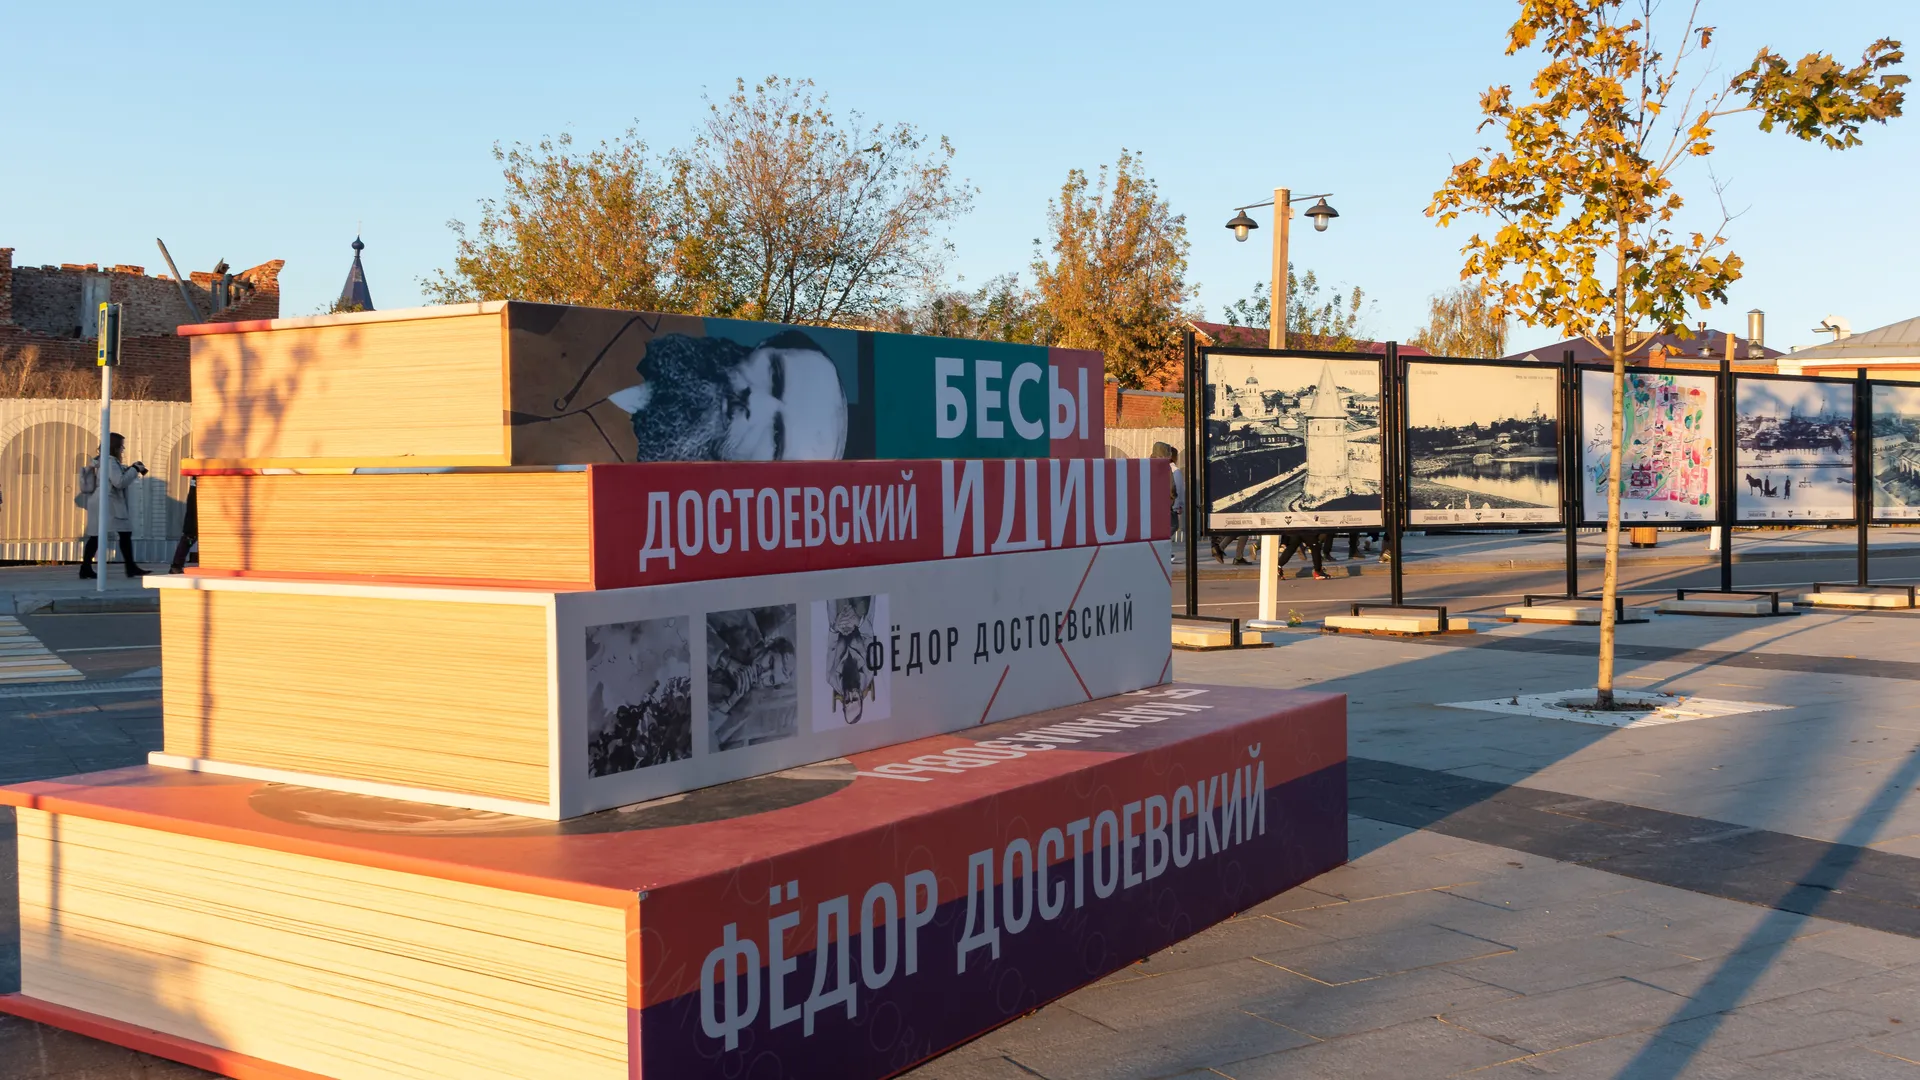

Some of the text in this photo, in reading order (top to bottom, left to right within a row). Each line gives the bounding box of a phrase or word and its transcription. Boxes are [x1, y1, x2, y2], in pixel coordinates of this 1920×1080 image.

[935, 357, 1088, 440] БЕСЫ
[639, 470, 917, 572] ДОСТОЕВСКИЙ
[866, 594, 1133, 676] ФЁДОР ДОСТОЕВСКИЙ
[700, 742, 1265, 1052] ФЁДОР ДОСТОЕВСКИЙ
